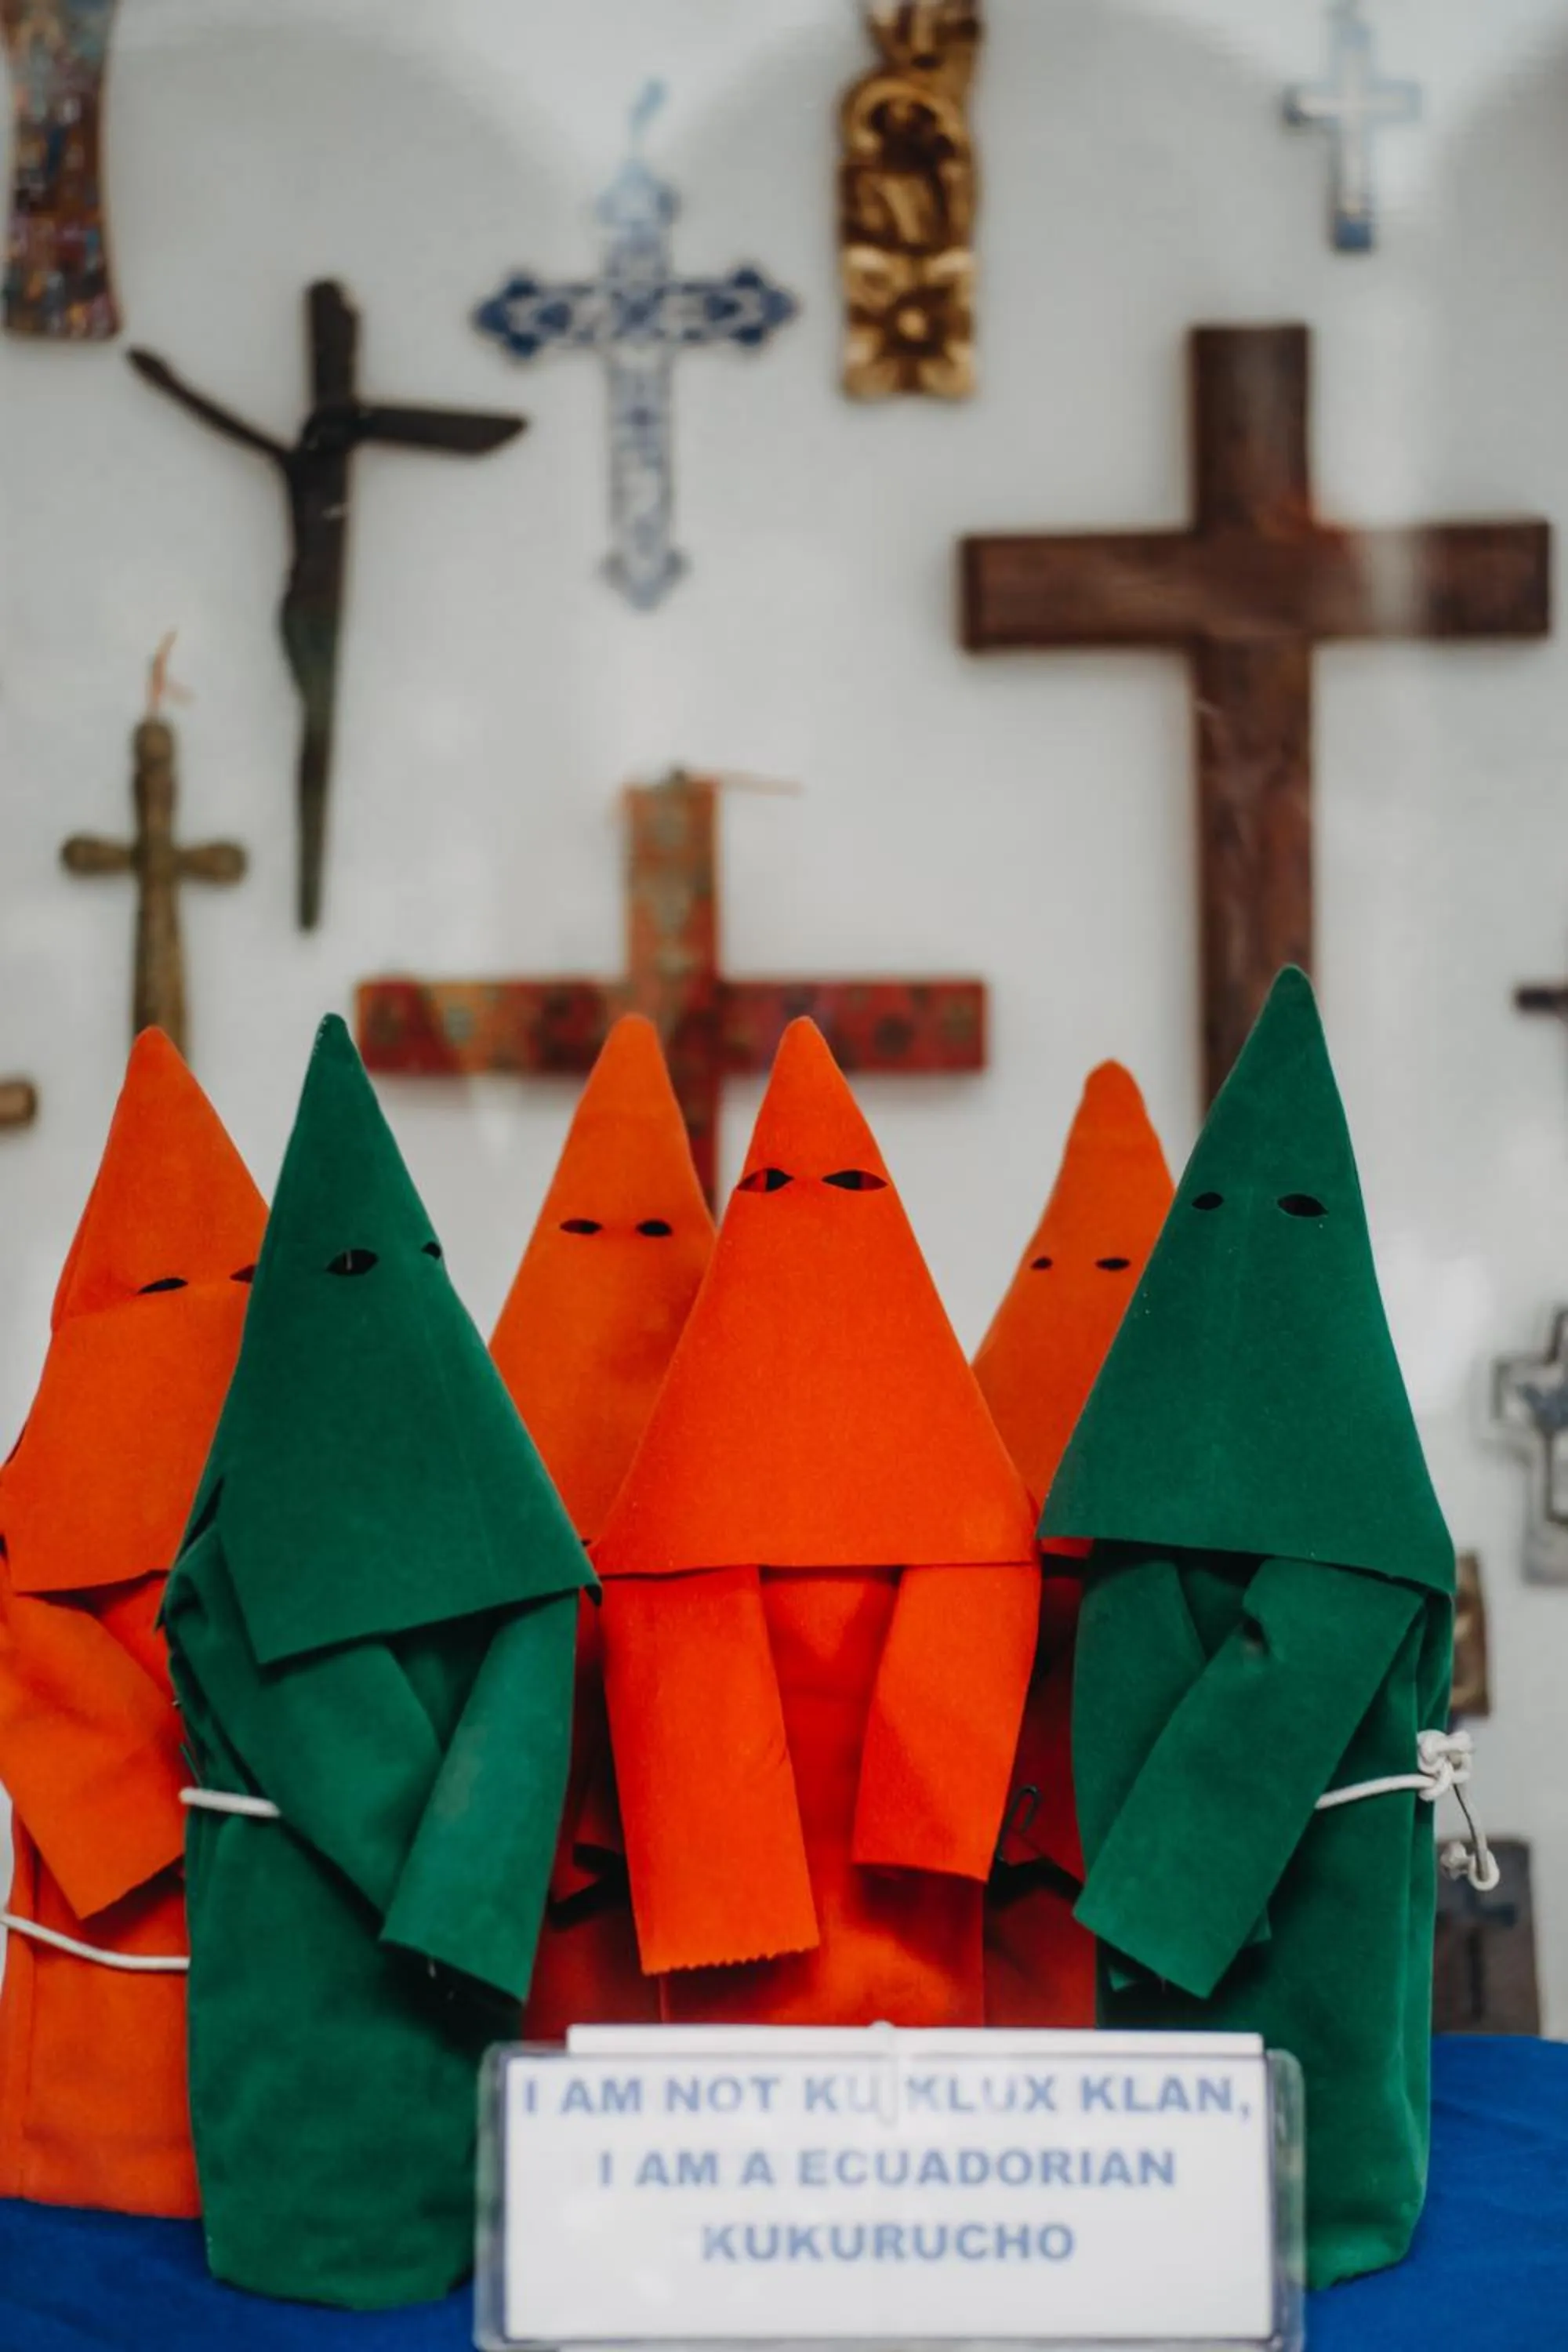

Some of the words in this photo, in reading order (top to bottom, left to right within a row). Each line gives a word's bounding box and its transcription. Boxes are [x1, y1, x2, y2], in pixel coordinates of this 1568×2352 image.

[522, 2075, 537, 2114] I
[558, 2075, 644, 2114] AM
[663, 2075, 781, 2114] NOT
[906, 2074, 1058, 2111] KLUX
[1079, 2074, 1250, 2120] KLAN,
[599, 2151, 612, 2186] I
[634, 2150, 719, 2187] AM
[739, 2150, 776, 2187] A
[796, 2149, 1176, 2187] ECUADORIAN
[701, 2223, 1077, 2263] KUKURUCHO
